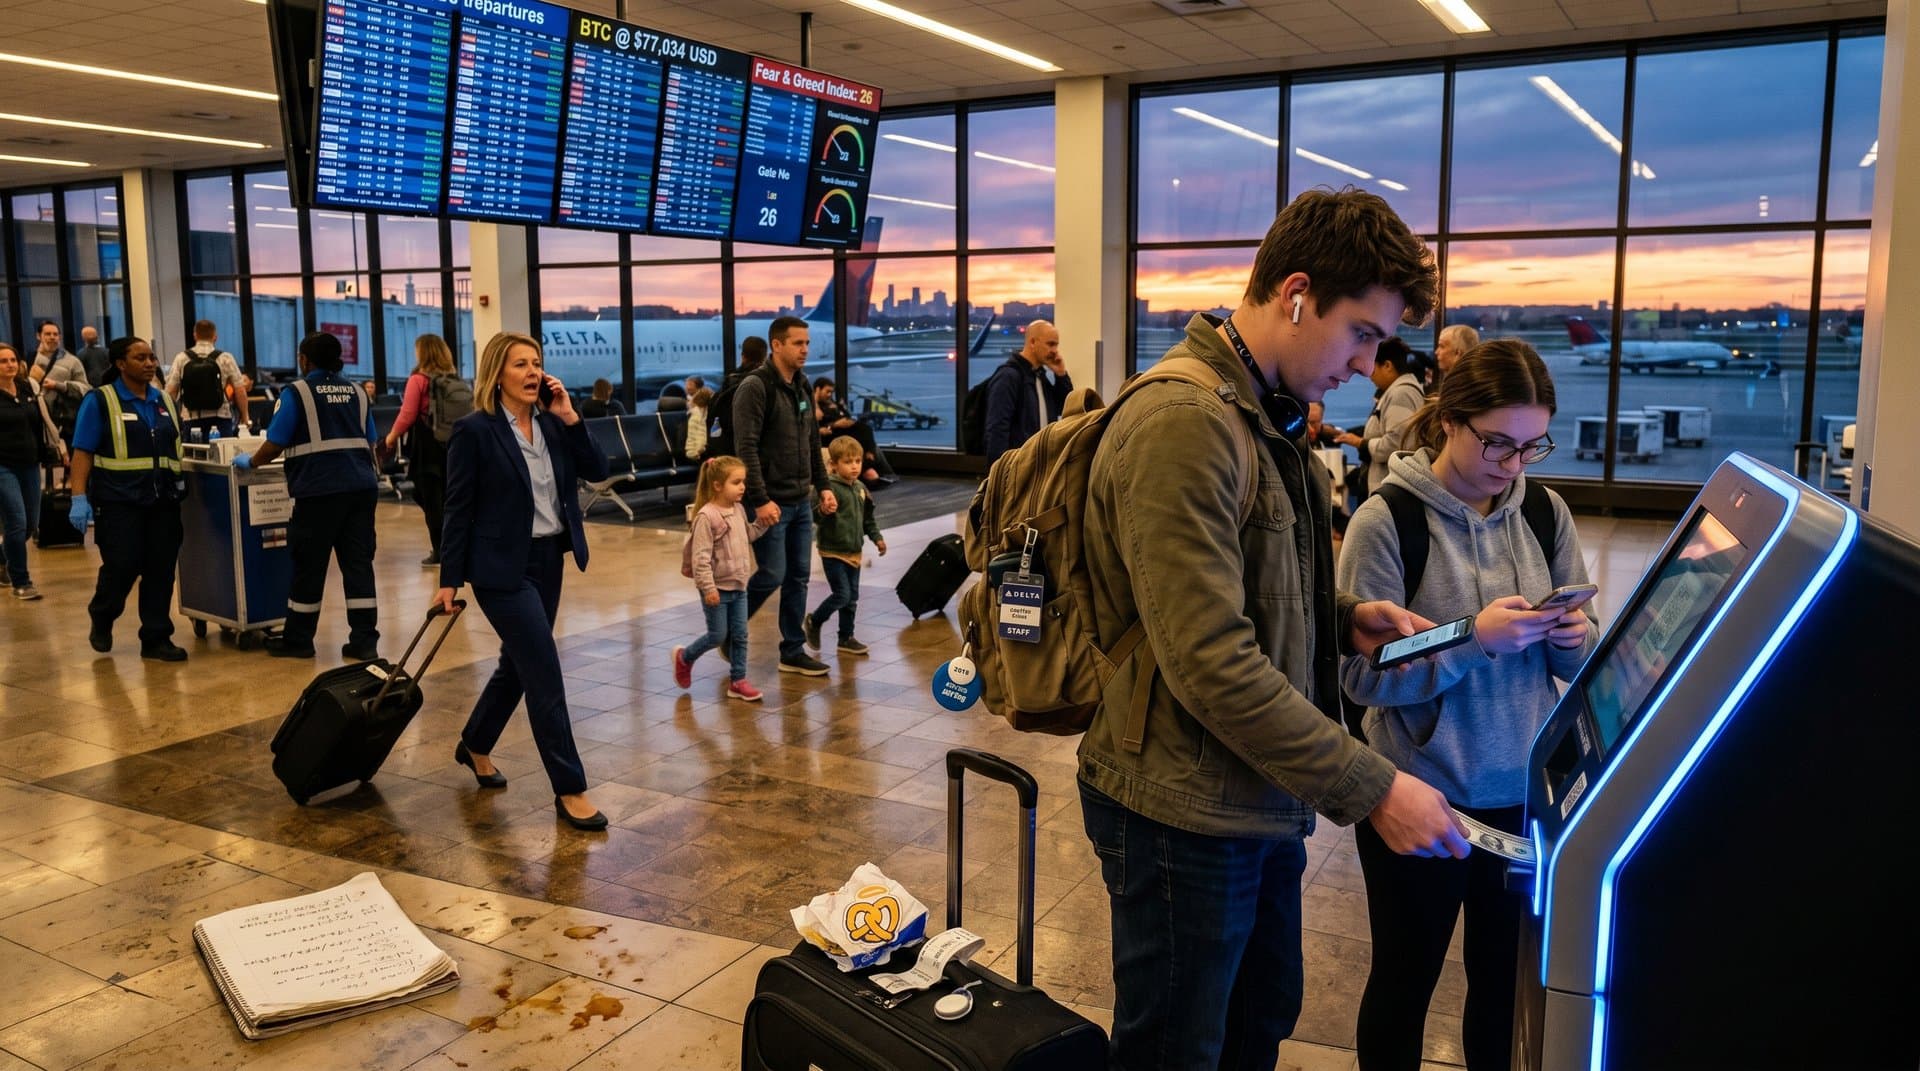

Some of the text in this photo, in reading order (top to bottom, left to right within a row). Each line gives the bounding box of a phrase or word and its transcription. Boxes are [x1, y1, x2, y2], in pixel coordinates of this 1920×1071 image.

[580, 18, 717, 66] BTC @ $77,034 USD
[755, 63, 873, 105] Fear & Greed Index: 26
[758, 207, 777, 227] 26
[1013, 591, 1040, 600] DELTA
[1007, 627, 1030, 636] STAFF
